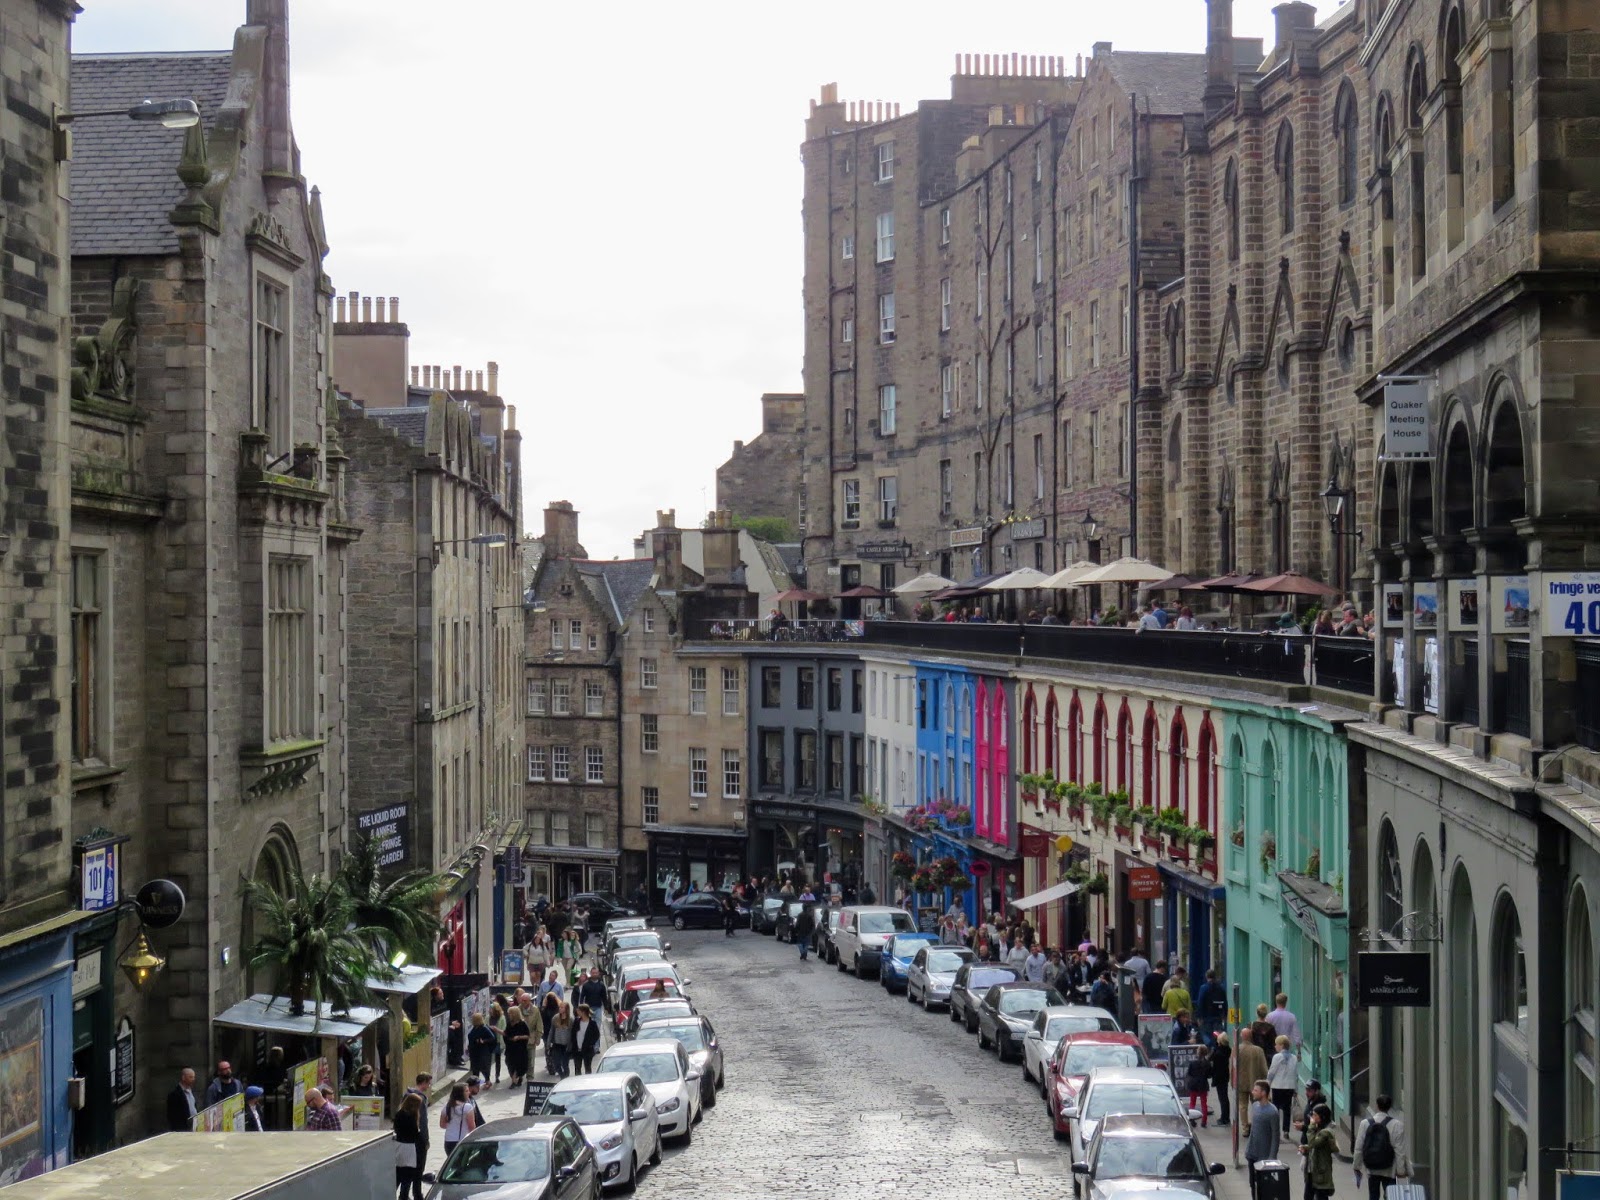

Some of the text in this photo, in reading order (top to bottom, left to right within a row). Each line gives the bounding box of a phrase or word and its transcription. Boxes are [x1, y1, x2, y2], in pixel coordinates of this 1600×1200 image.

[1390, 401, 1423, 410] Quaker
[1389, 415, 1425, 425] Meeting
[1393, 429, 1422, 438] House
[1549, 581, 1584, 597] fringe
[359, 806, 406, 828] THE LIQUID ROOM
[380, 849, 404, 866] GARDEN
[88, 866, 103, 892] 101
